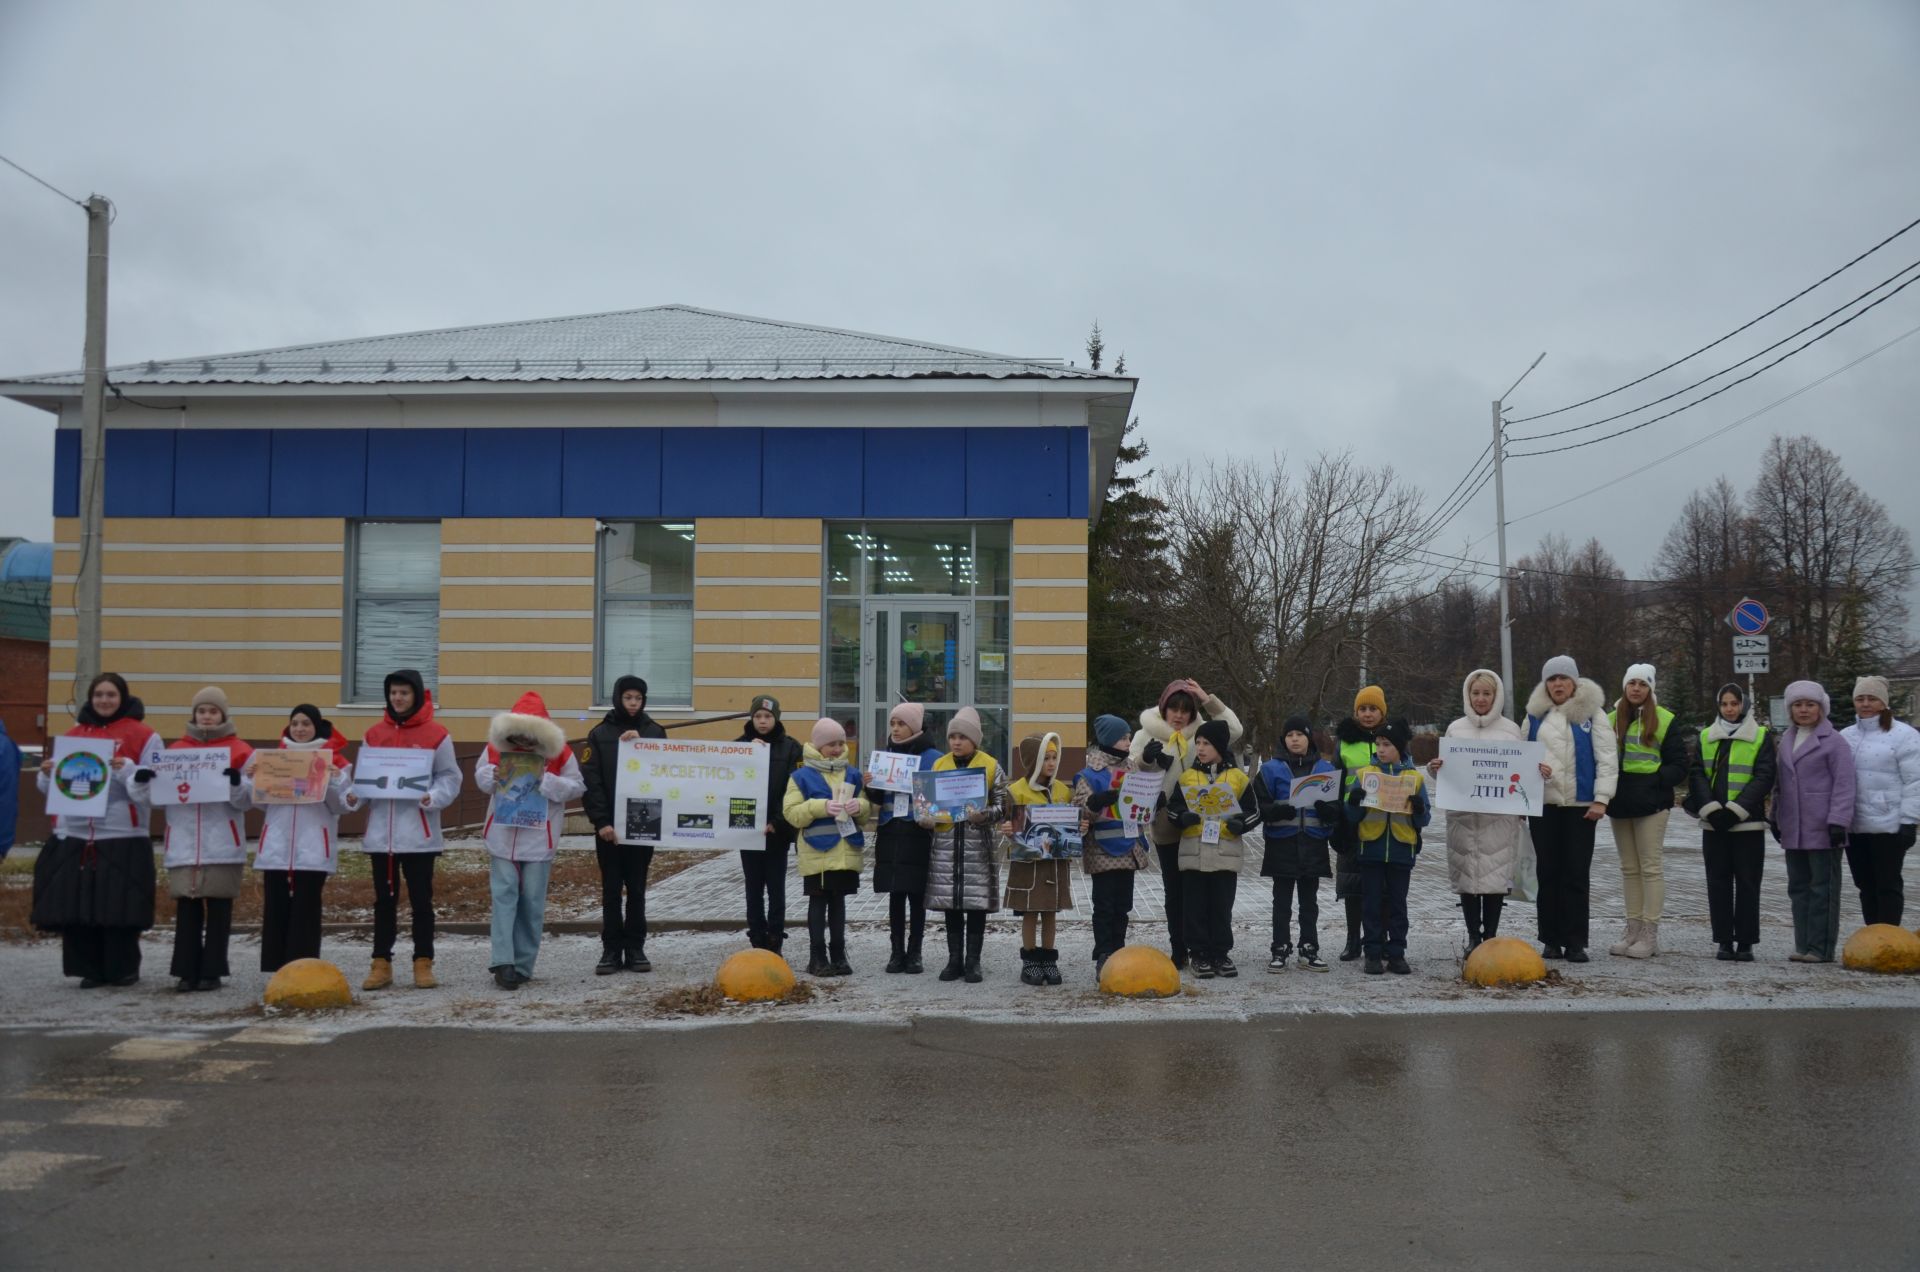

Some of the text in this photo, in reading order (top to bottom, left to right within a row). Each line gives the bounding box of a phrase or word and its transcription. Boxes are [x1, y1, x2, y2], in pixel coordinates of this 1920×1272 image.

[1744, 660, 1754, 668] 20
[634, 742, 660, 751] СТАНЬ
[662, 743, 706, 753] ЗАМЕТНЕЙ
[721, 746, 753, 755] ДОРОГЕ
[1450, 746, 1522, 756] ВСЕМИРНЫЙ ДЕНЬ
[1472, 760, 1508, 769] ПАМЯТИ
[650, 763, 736, 781] ЗАСВЕТИСЬ
[1476, 773, 1504, 781] ЖЕРТВ
[1366, 779, 1378, 789] 40
[1470, 785, 1505, 798] ДТП
